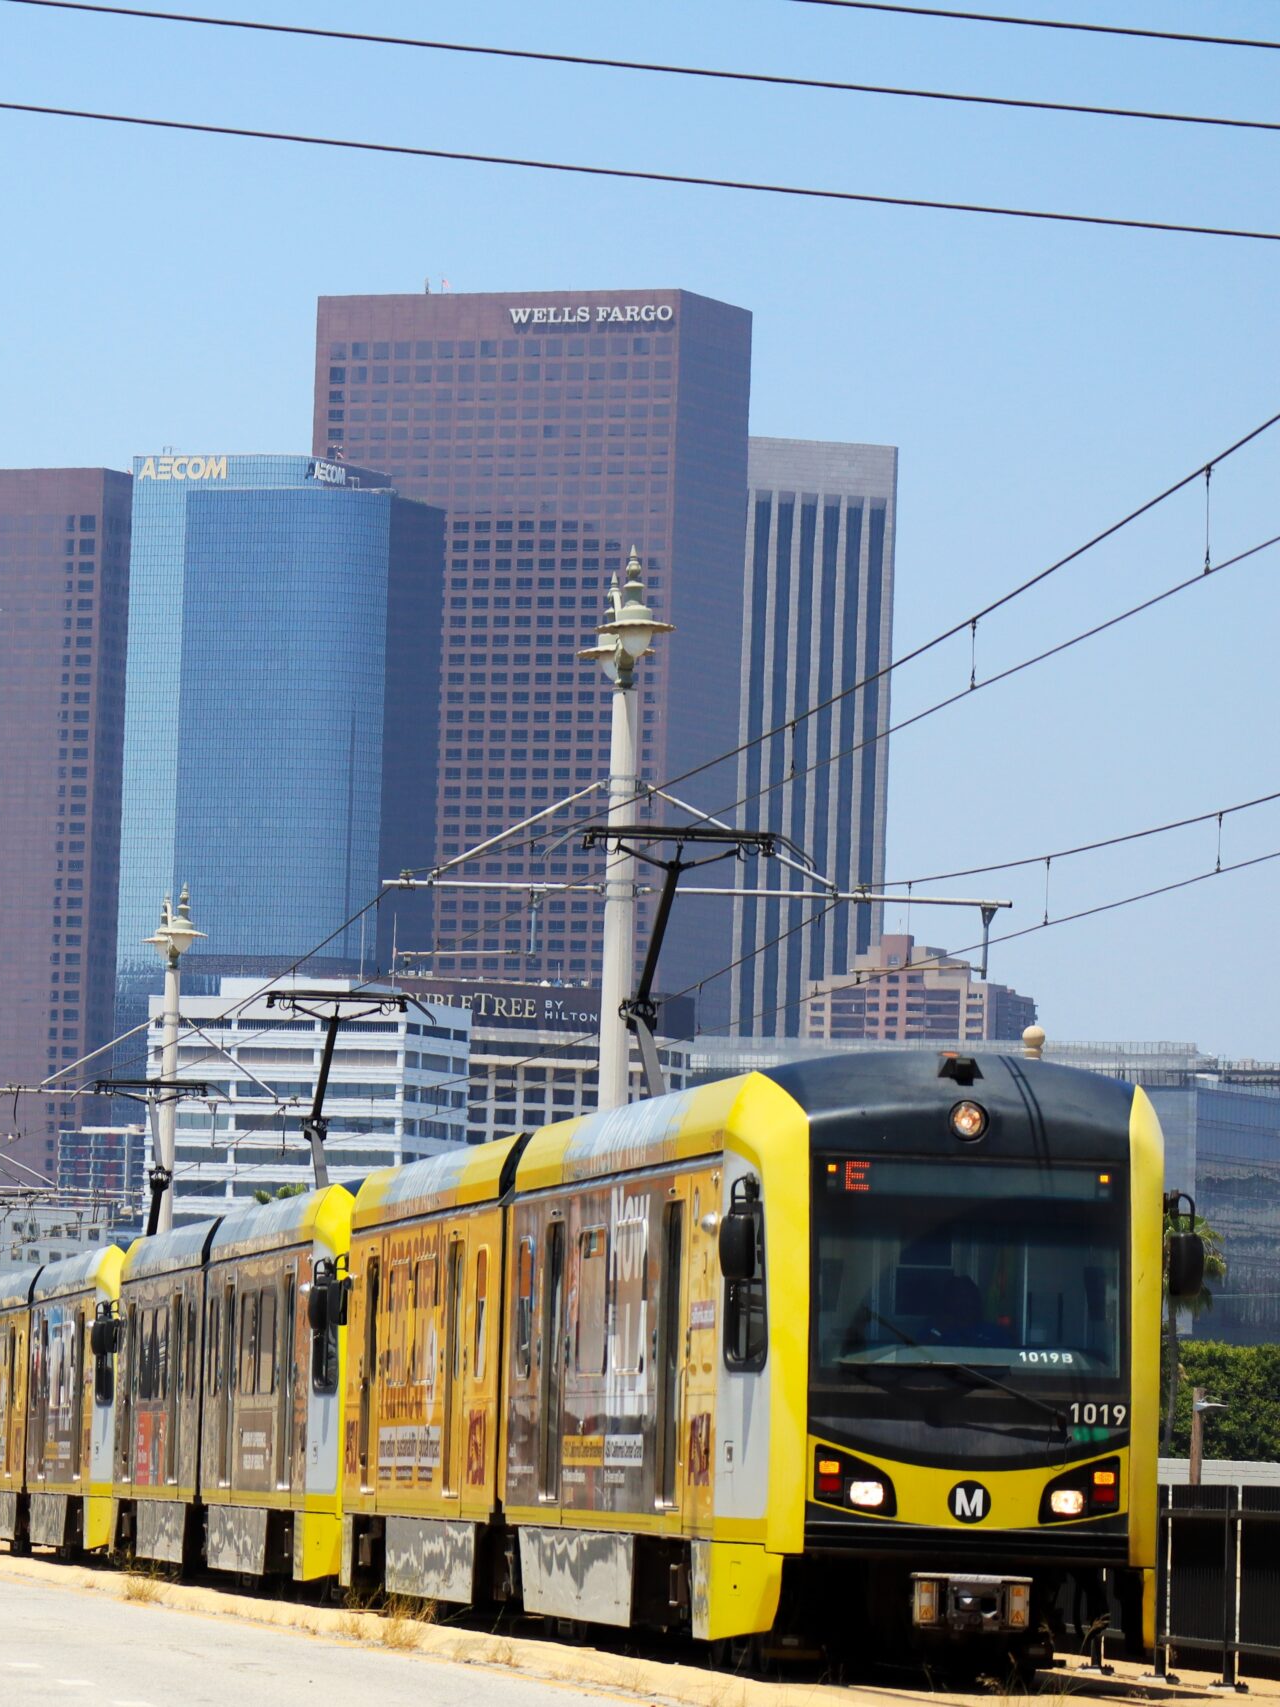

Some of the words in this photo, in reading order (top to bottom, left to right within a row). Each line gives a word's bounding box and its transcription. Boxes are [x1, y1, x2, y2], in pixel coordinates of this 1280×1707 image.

[509, 305, 591, 325] WELLS
[595, 304, 673, 323] FARGO
[138, 456, 228, 481] AECOM
[313, 460, 346, 486] AECOM
[545, 1000, 563, 1009] BY
[545, 1011, 598, 1022] HILTON
[845, 1160, 870, 1191] E
[1019, 1351, 1073, 1364] 1019B
[1070, 1402, 1127, 1426] 1019
[955, 1487, 984, 1517] M
